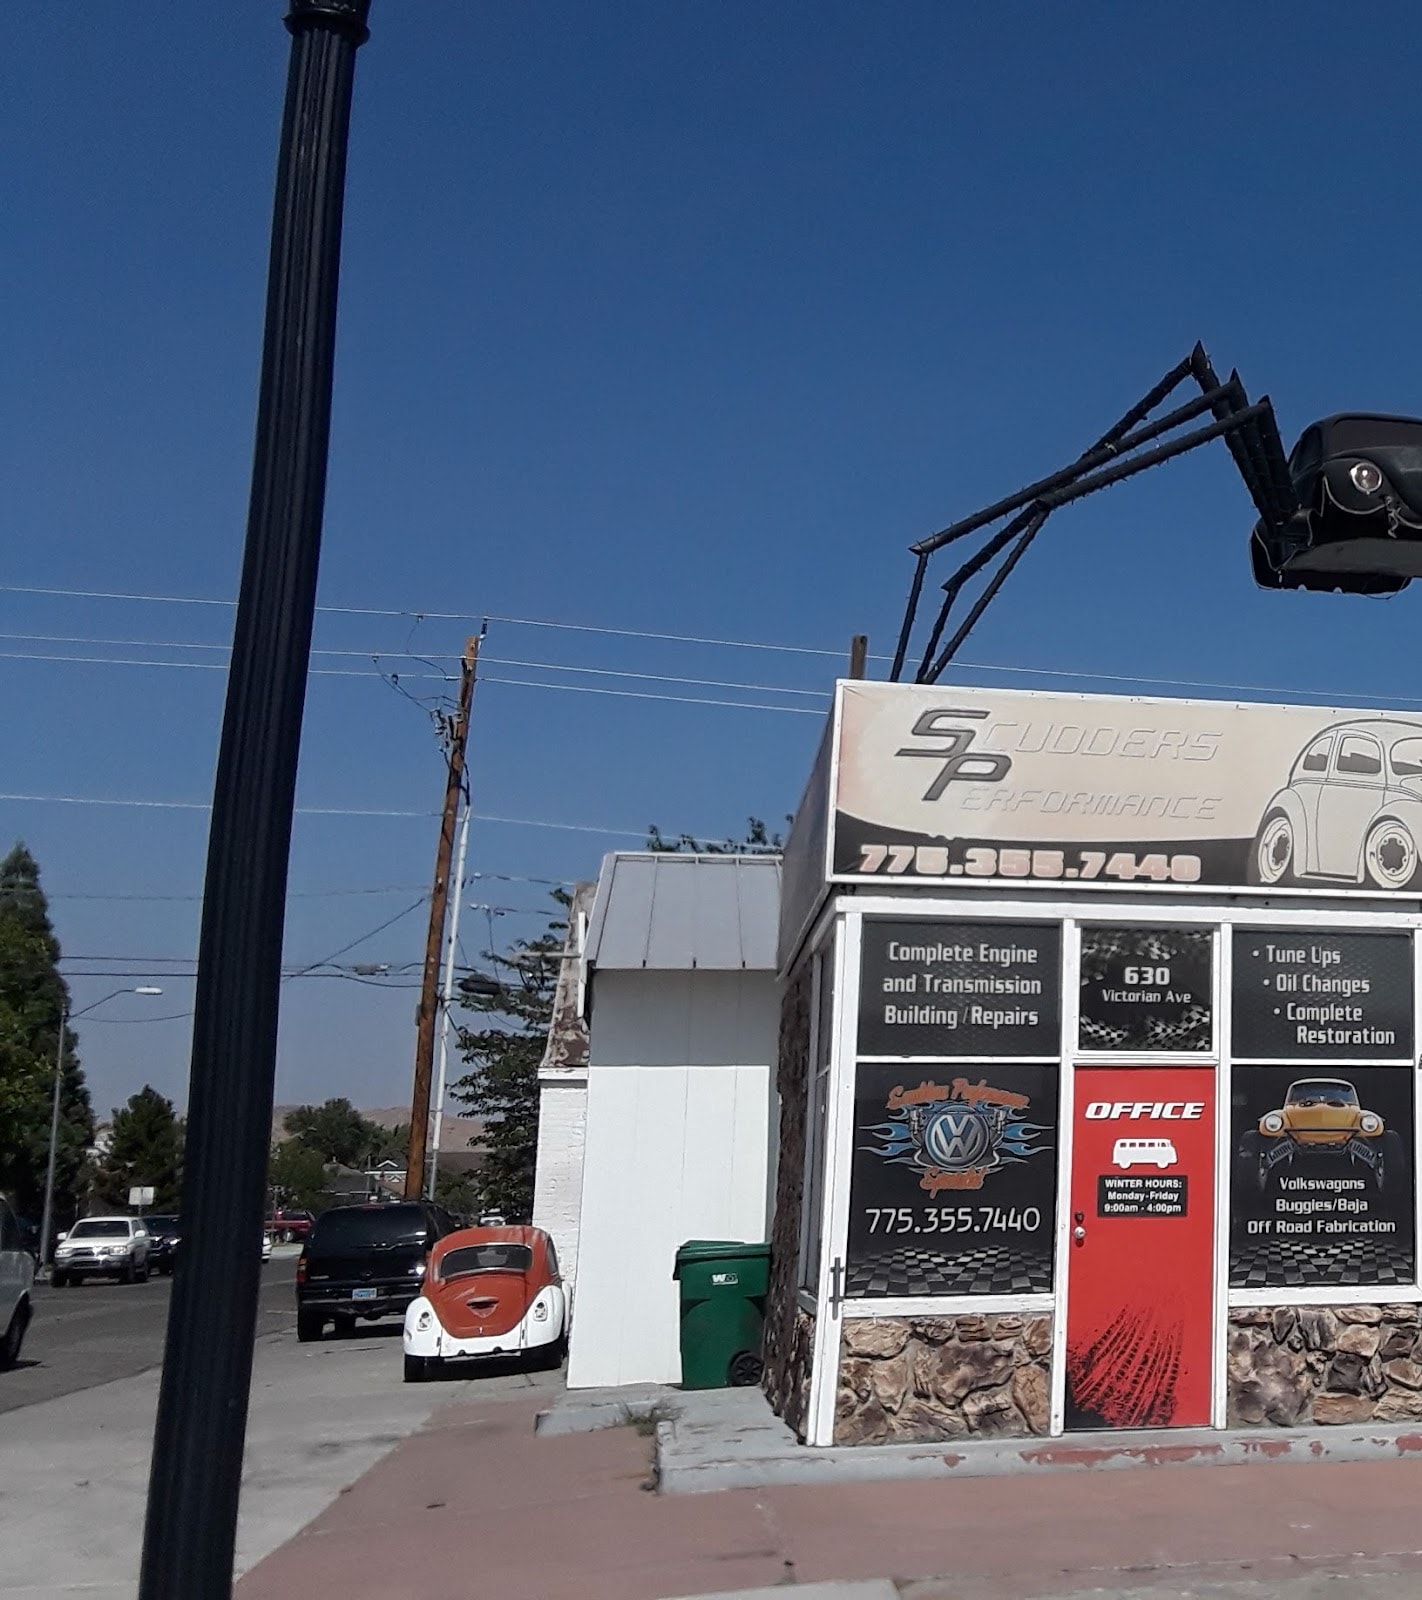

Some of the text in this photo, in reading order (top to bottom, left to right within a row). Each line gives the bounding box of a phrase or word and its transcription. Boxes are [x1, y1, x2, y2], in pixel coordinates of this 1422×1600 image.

[859, 844, 1202, 882] 775.355.7440
[889, 942, 1038, 967] Complete Engine
[1266, 945, 1341, 968] Tune Ups
[883, 974, 1041, 994] and Transmission
[1124, 966, 1171, 985] 630
[1276, 974, 1370, 997] Oil Changes
[1102, 989, 1192, 1003] Victorian Ave
[1287, 1002, 1363, 1025] Complete
[1296, 1025, 1395, 1045] Restoration
[1085, 1102, 1205, 1120] OFFICE
[1104, 1179, 1183, 1188] WINTER HOURS:
[1280, 1176, 1366, 1193] Volkswagons
[1104, 1203, 1138, 1213] 9:00am
[1147, 1203, 1182, 1214] 4:00pm
[1275, 1198, 1368, 1215] Buggies/Baja
[865, 1207, 1041, 1234] 775.355.7440
[1248, 1220, 1396, 1234] Off Road Fabrication
